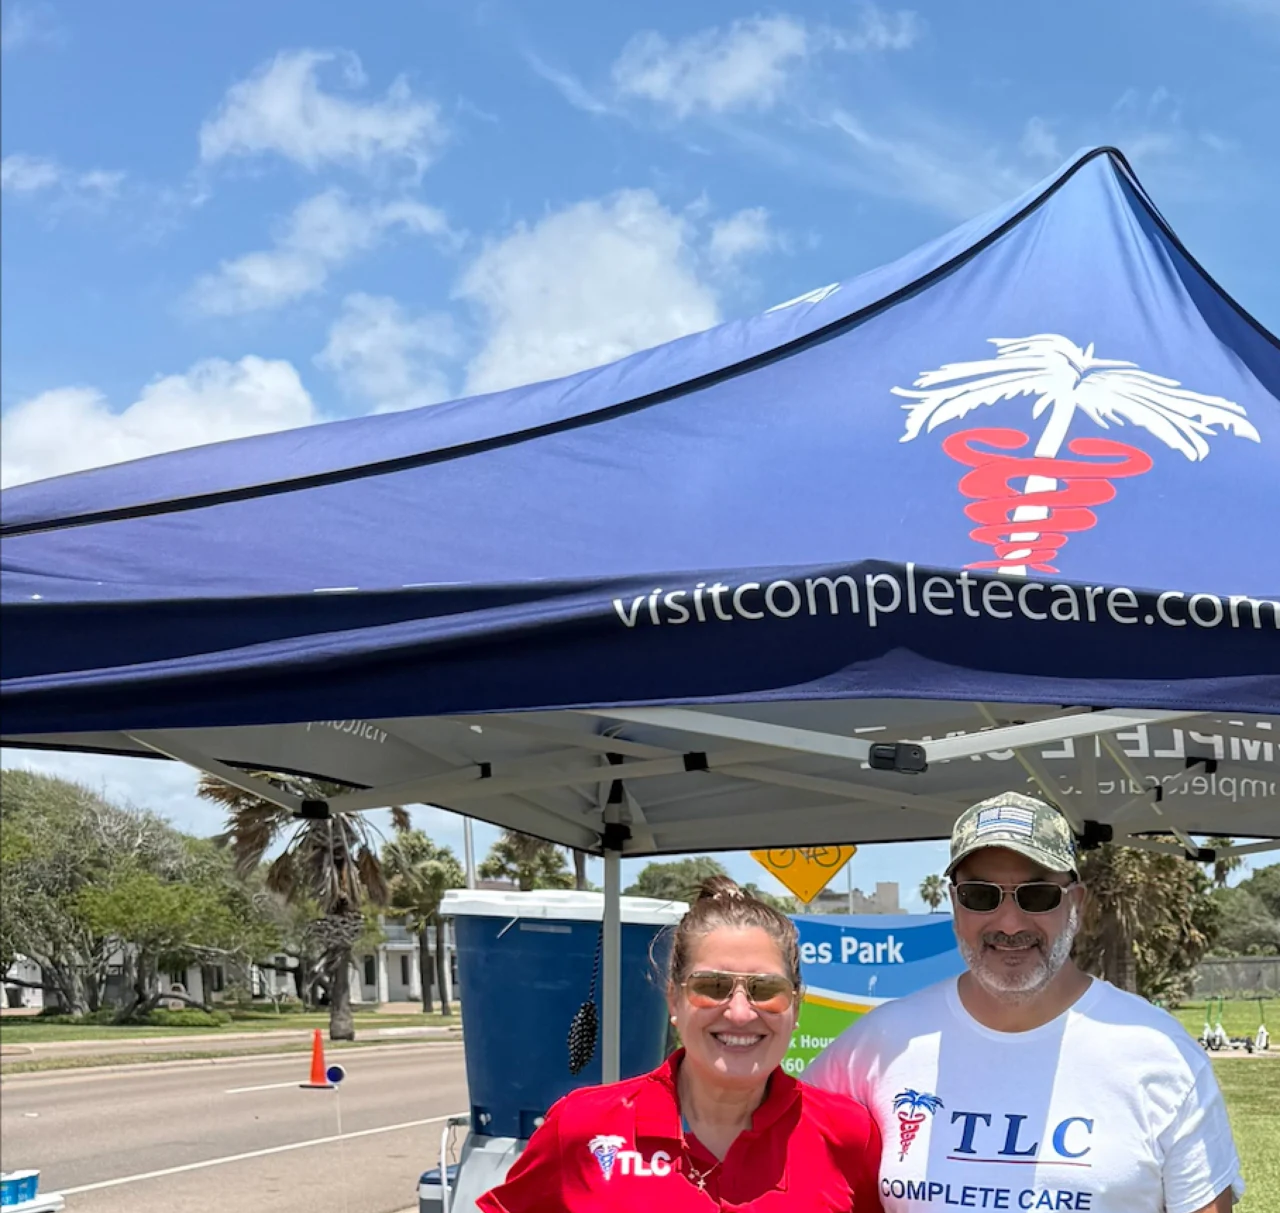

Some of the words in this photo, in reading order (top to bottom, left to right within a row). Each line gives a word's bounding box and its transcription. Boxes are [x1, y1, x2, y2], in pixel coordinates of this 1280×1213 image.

[840, 935, 905, 964] Park
[950, 1110, 1094, 1159] TLC
[617, 1150, 671, 1177] TLC
[881, 1178, 1011, 1209] COMPLETE
[1018, 1189, 1093, 1212] CARE
